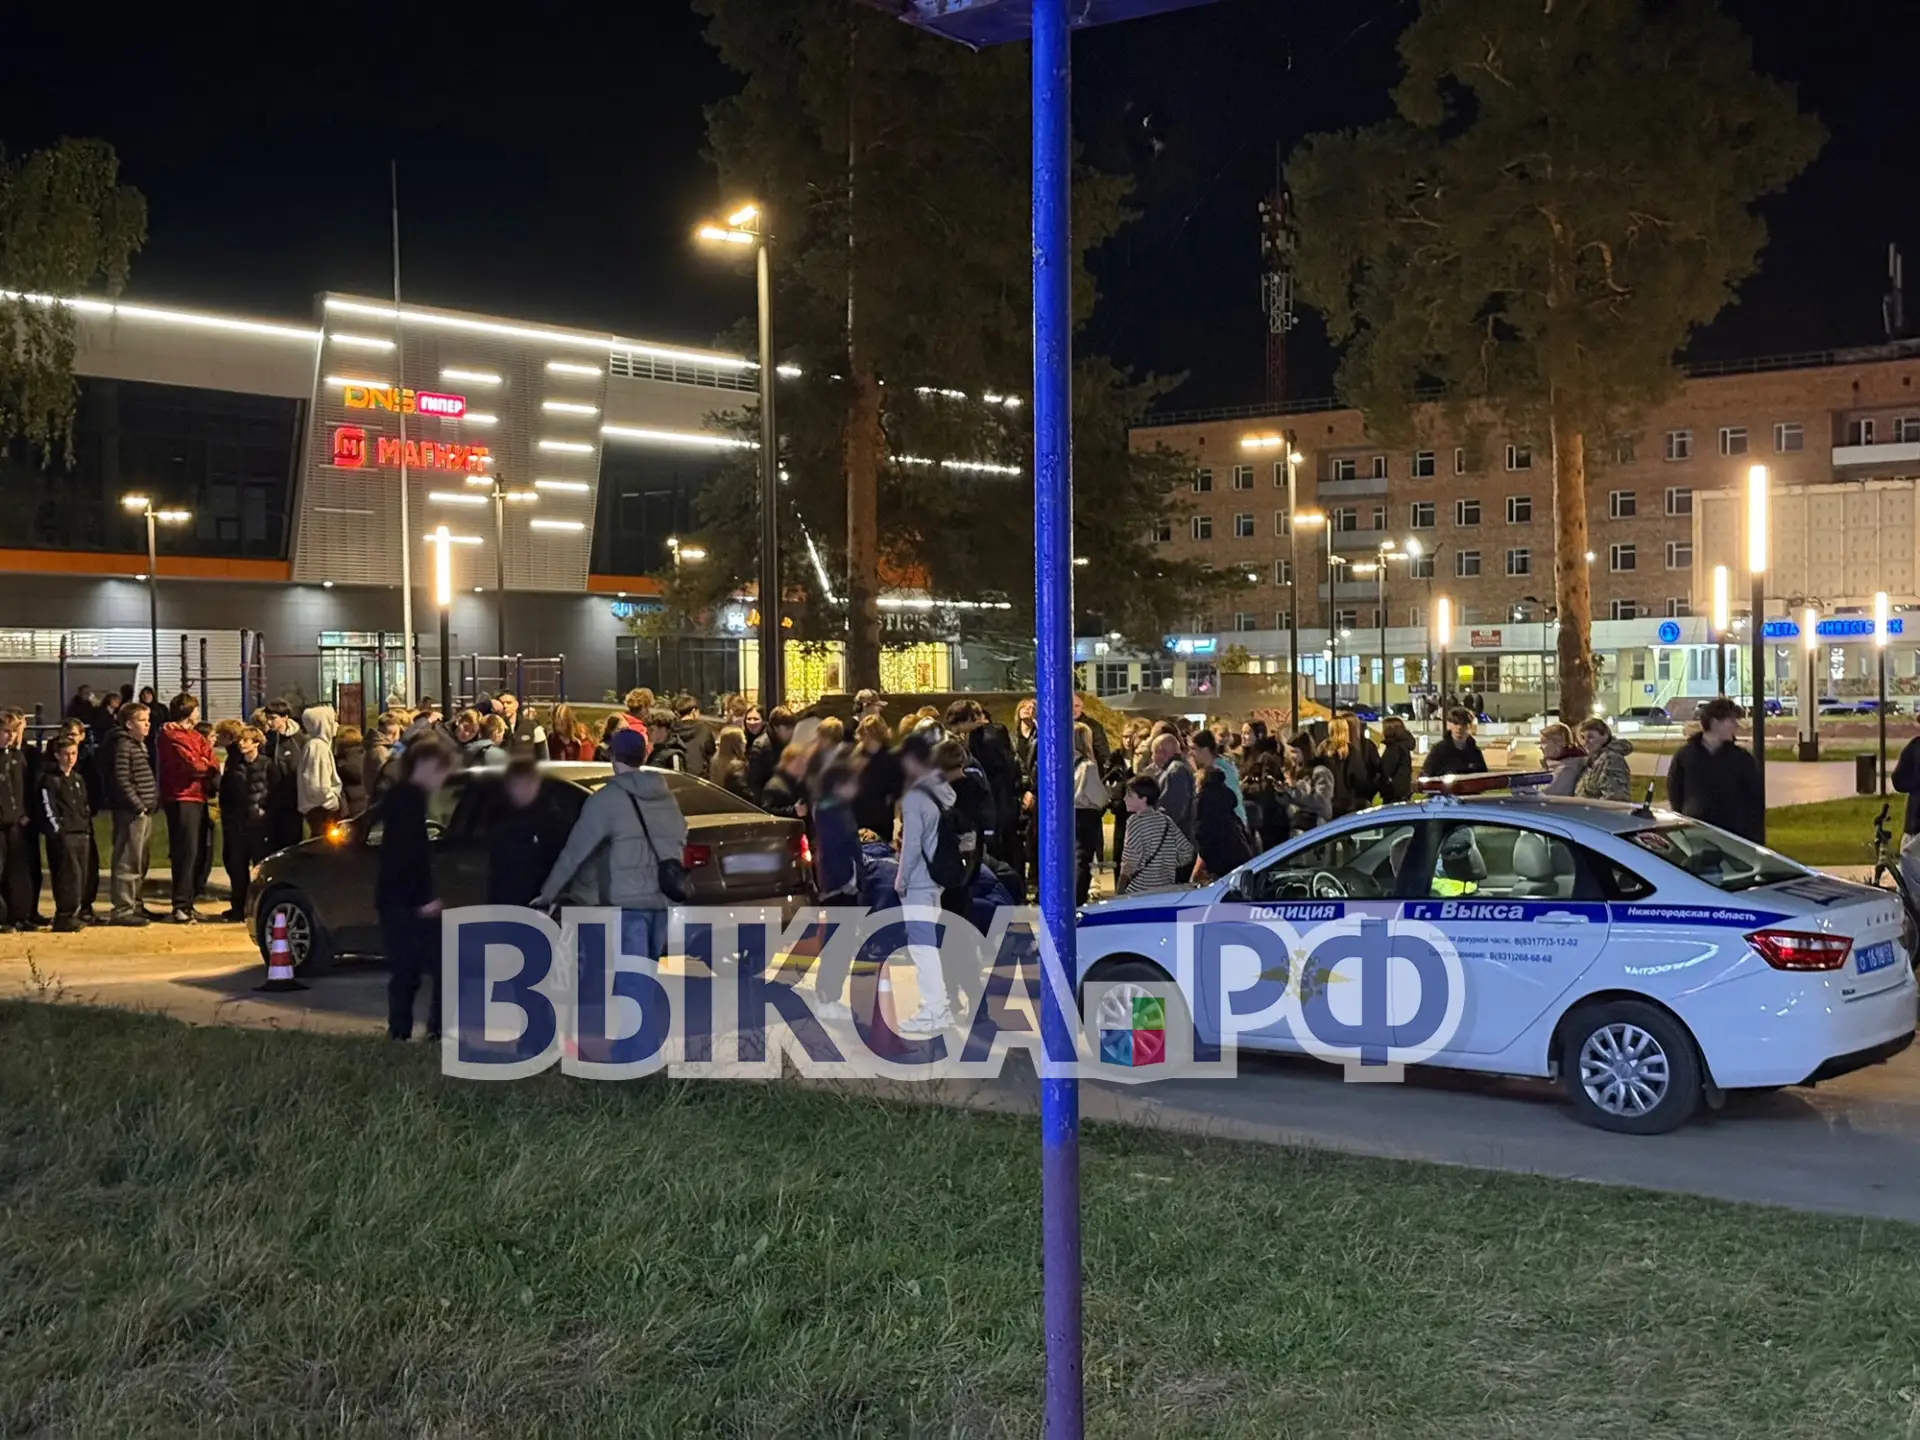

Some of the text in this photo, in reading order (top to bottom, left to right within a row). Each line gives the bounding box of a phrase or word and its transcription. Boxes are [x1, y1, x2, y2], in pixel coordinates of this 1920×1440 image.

[344, 385, 416, 414] DNS
[377, 436, 490, 472] МАГНИТ
[1414, 901, 1524, 919] г. Выкса
[1712, 910, 1756, 921] область
